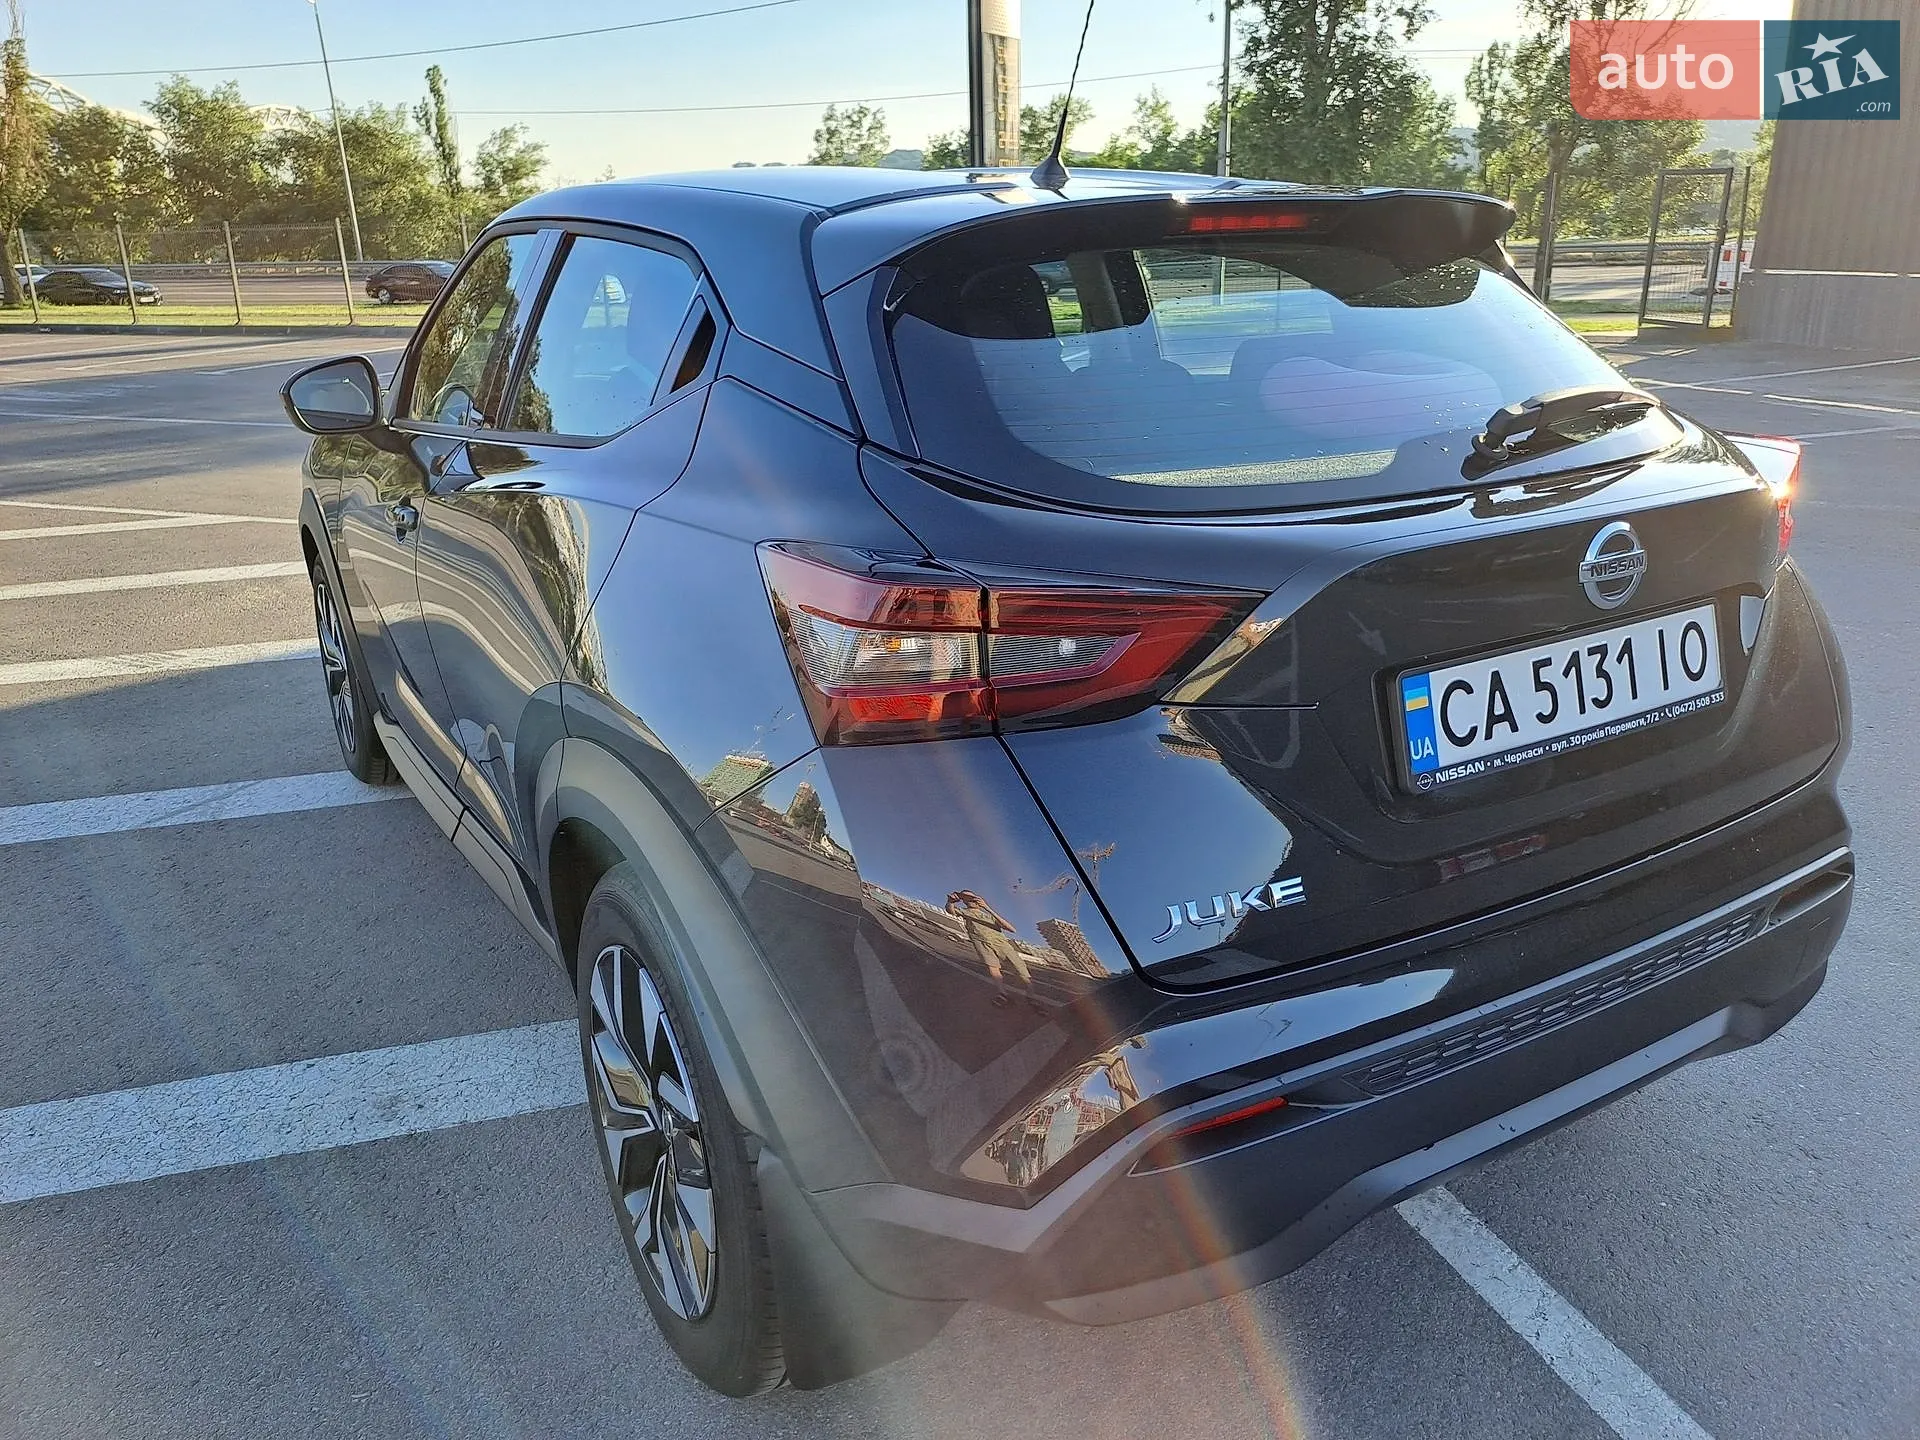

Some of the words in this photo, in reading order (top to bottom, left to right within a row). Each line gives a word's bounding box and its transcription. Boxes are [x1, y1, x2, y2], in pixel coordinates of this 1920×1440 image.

[1589, 554, 1644, 578] NISSAN
[1439, 669, 1520, 748] CA
[1531, 636, 1639, 725] 5131
[1656, 620, 1708, 692] IO
[1410, 736, 1435, 760] UA
[1435, 760, 1486, 784] NISSAN
[1504, 745, 1544, 764] Черкаси
[1551, 738, 1570, 752] вул.
[1672, 700, 1696, 718] (0472)
[1697, 697, 1710, 709] 508
[1711, 691, 1725, 703] 333
[1152, 876, 1307, 944] JUKE
